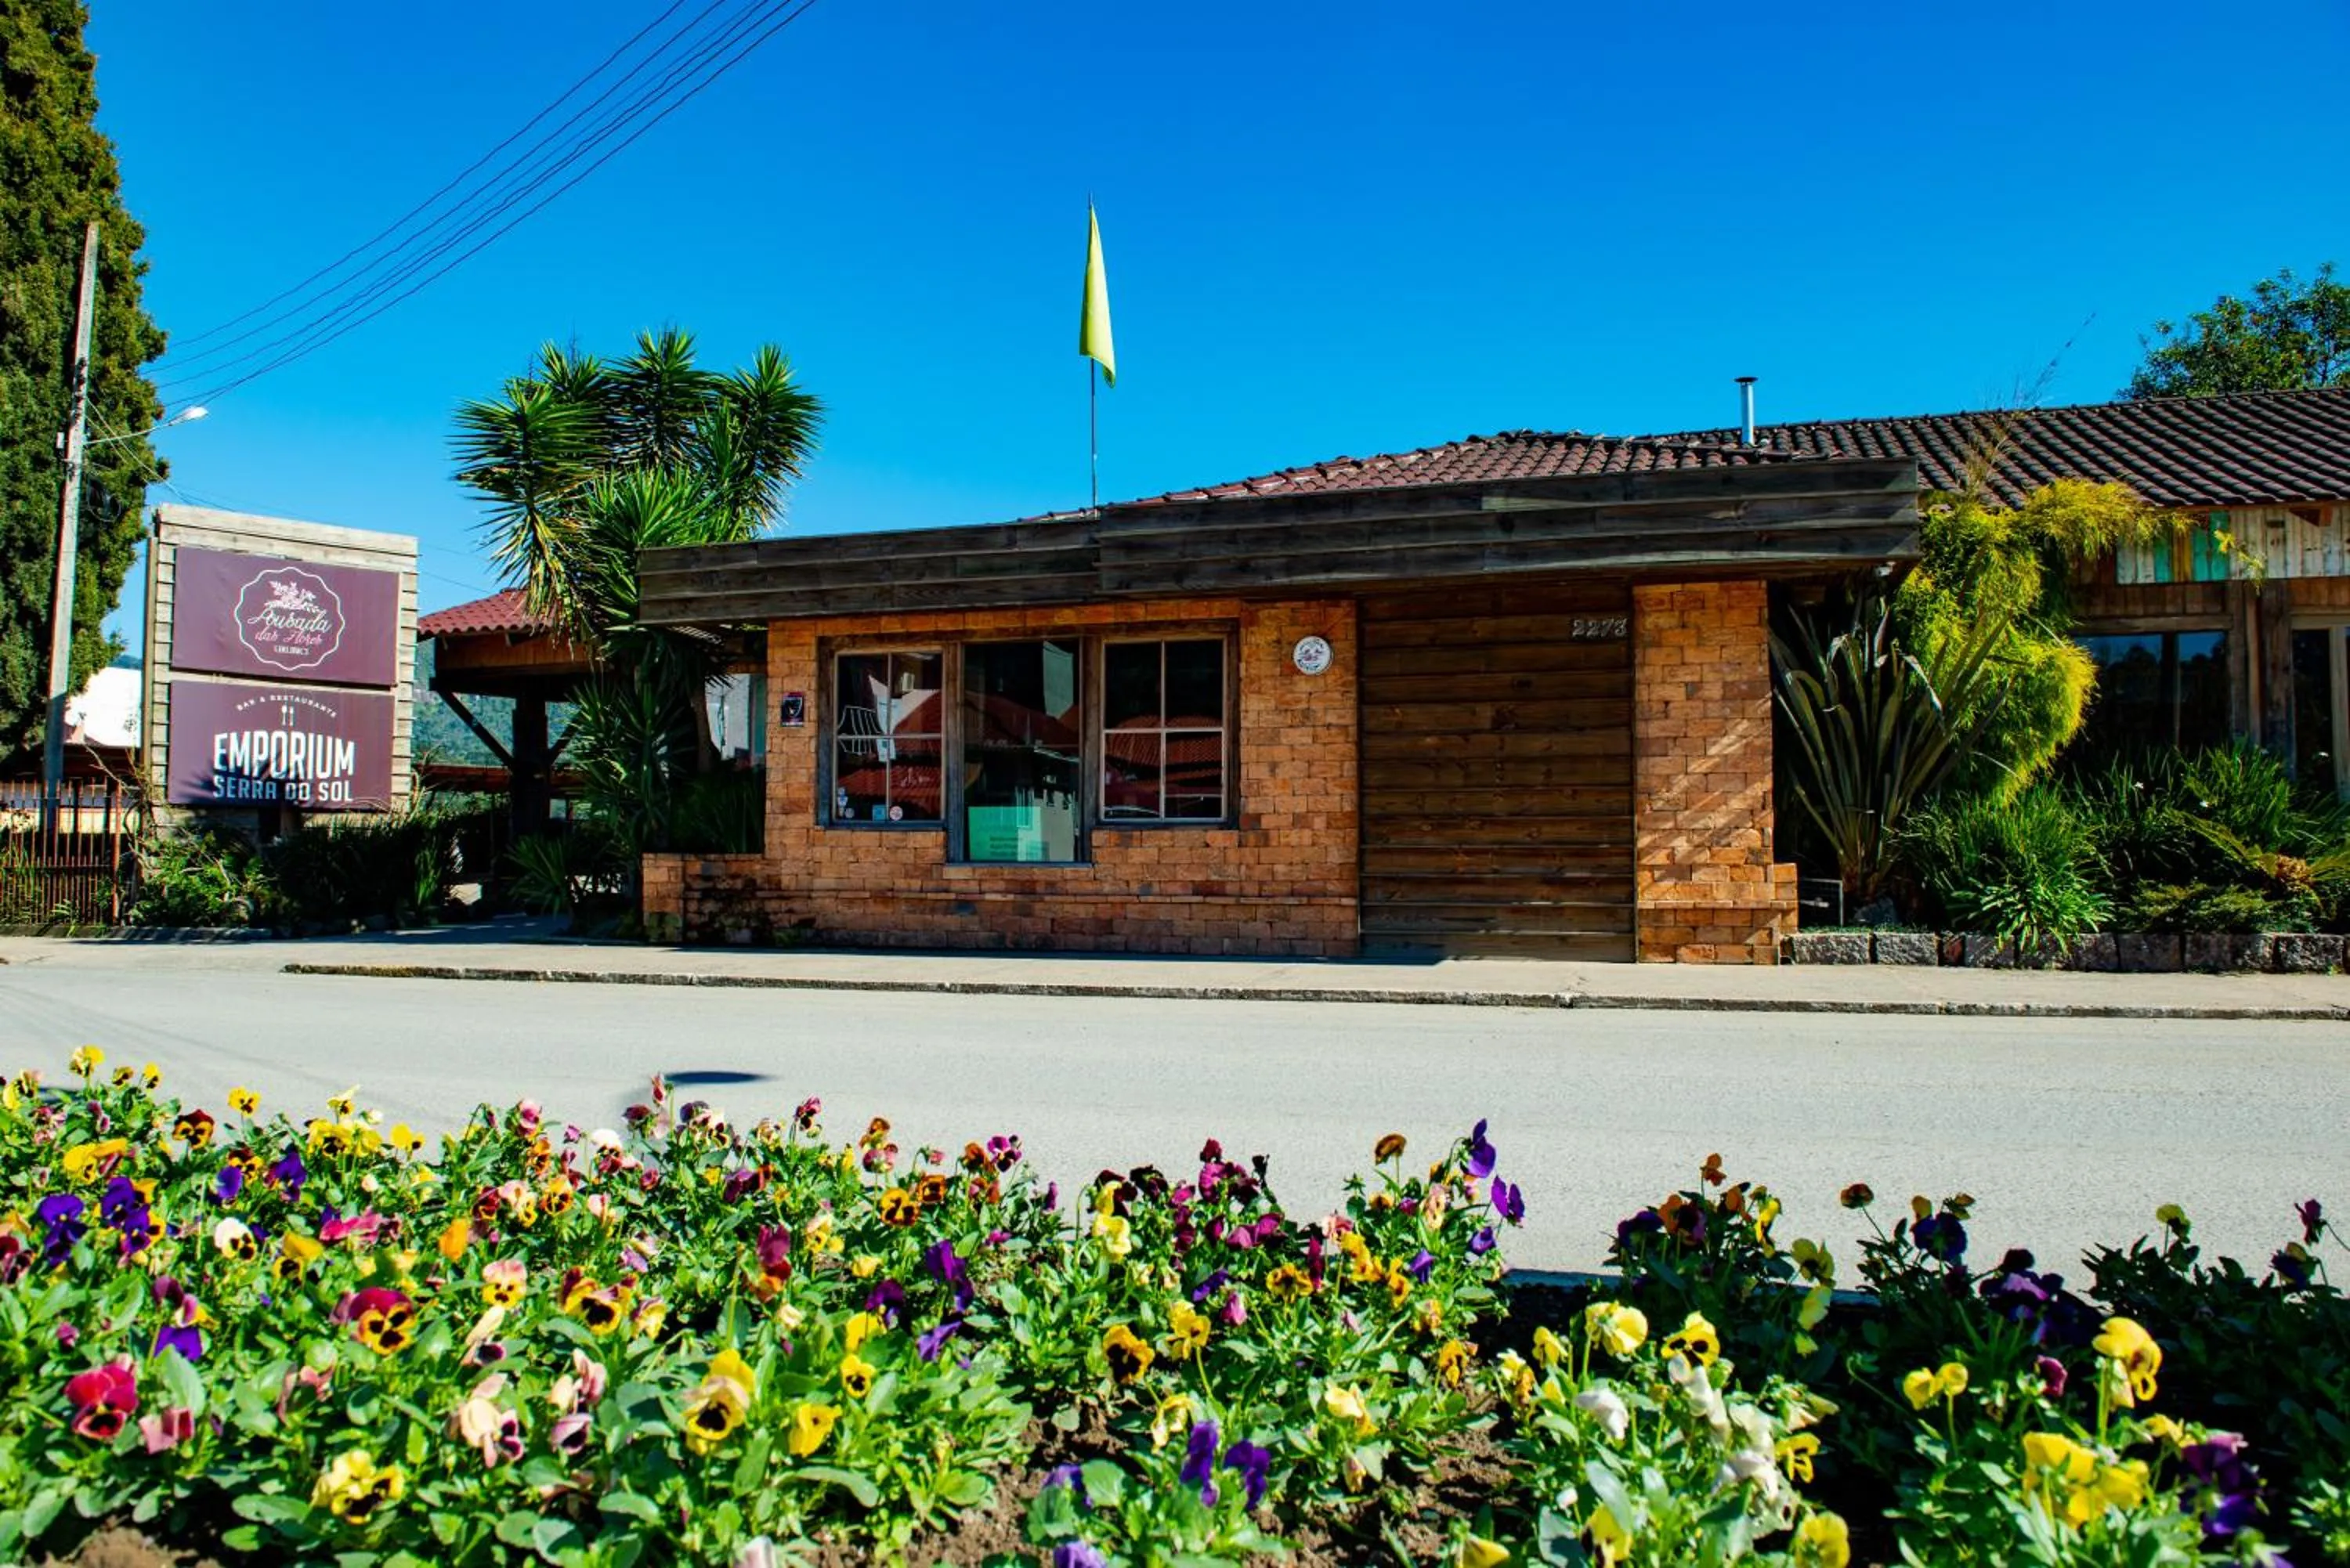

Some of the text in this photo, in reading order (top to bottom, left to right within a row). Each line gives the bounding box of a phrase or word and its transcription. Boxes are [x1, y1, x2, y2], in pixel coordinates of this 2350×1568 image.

[248, 609, 331, 633] Pousada
[255, 626, 278, 641] das
[237, 699, 255, 711] BAR
[270, 695, 337, 717] RESTAURANTE
[214, 730, 355, 780] EMPORIUM
[213, 775, 353, 800] SERRA DO SOL
